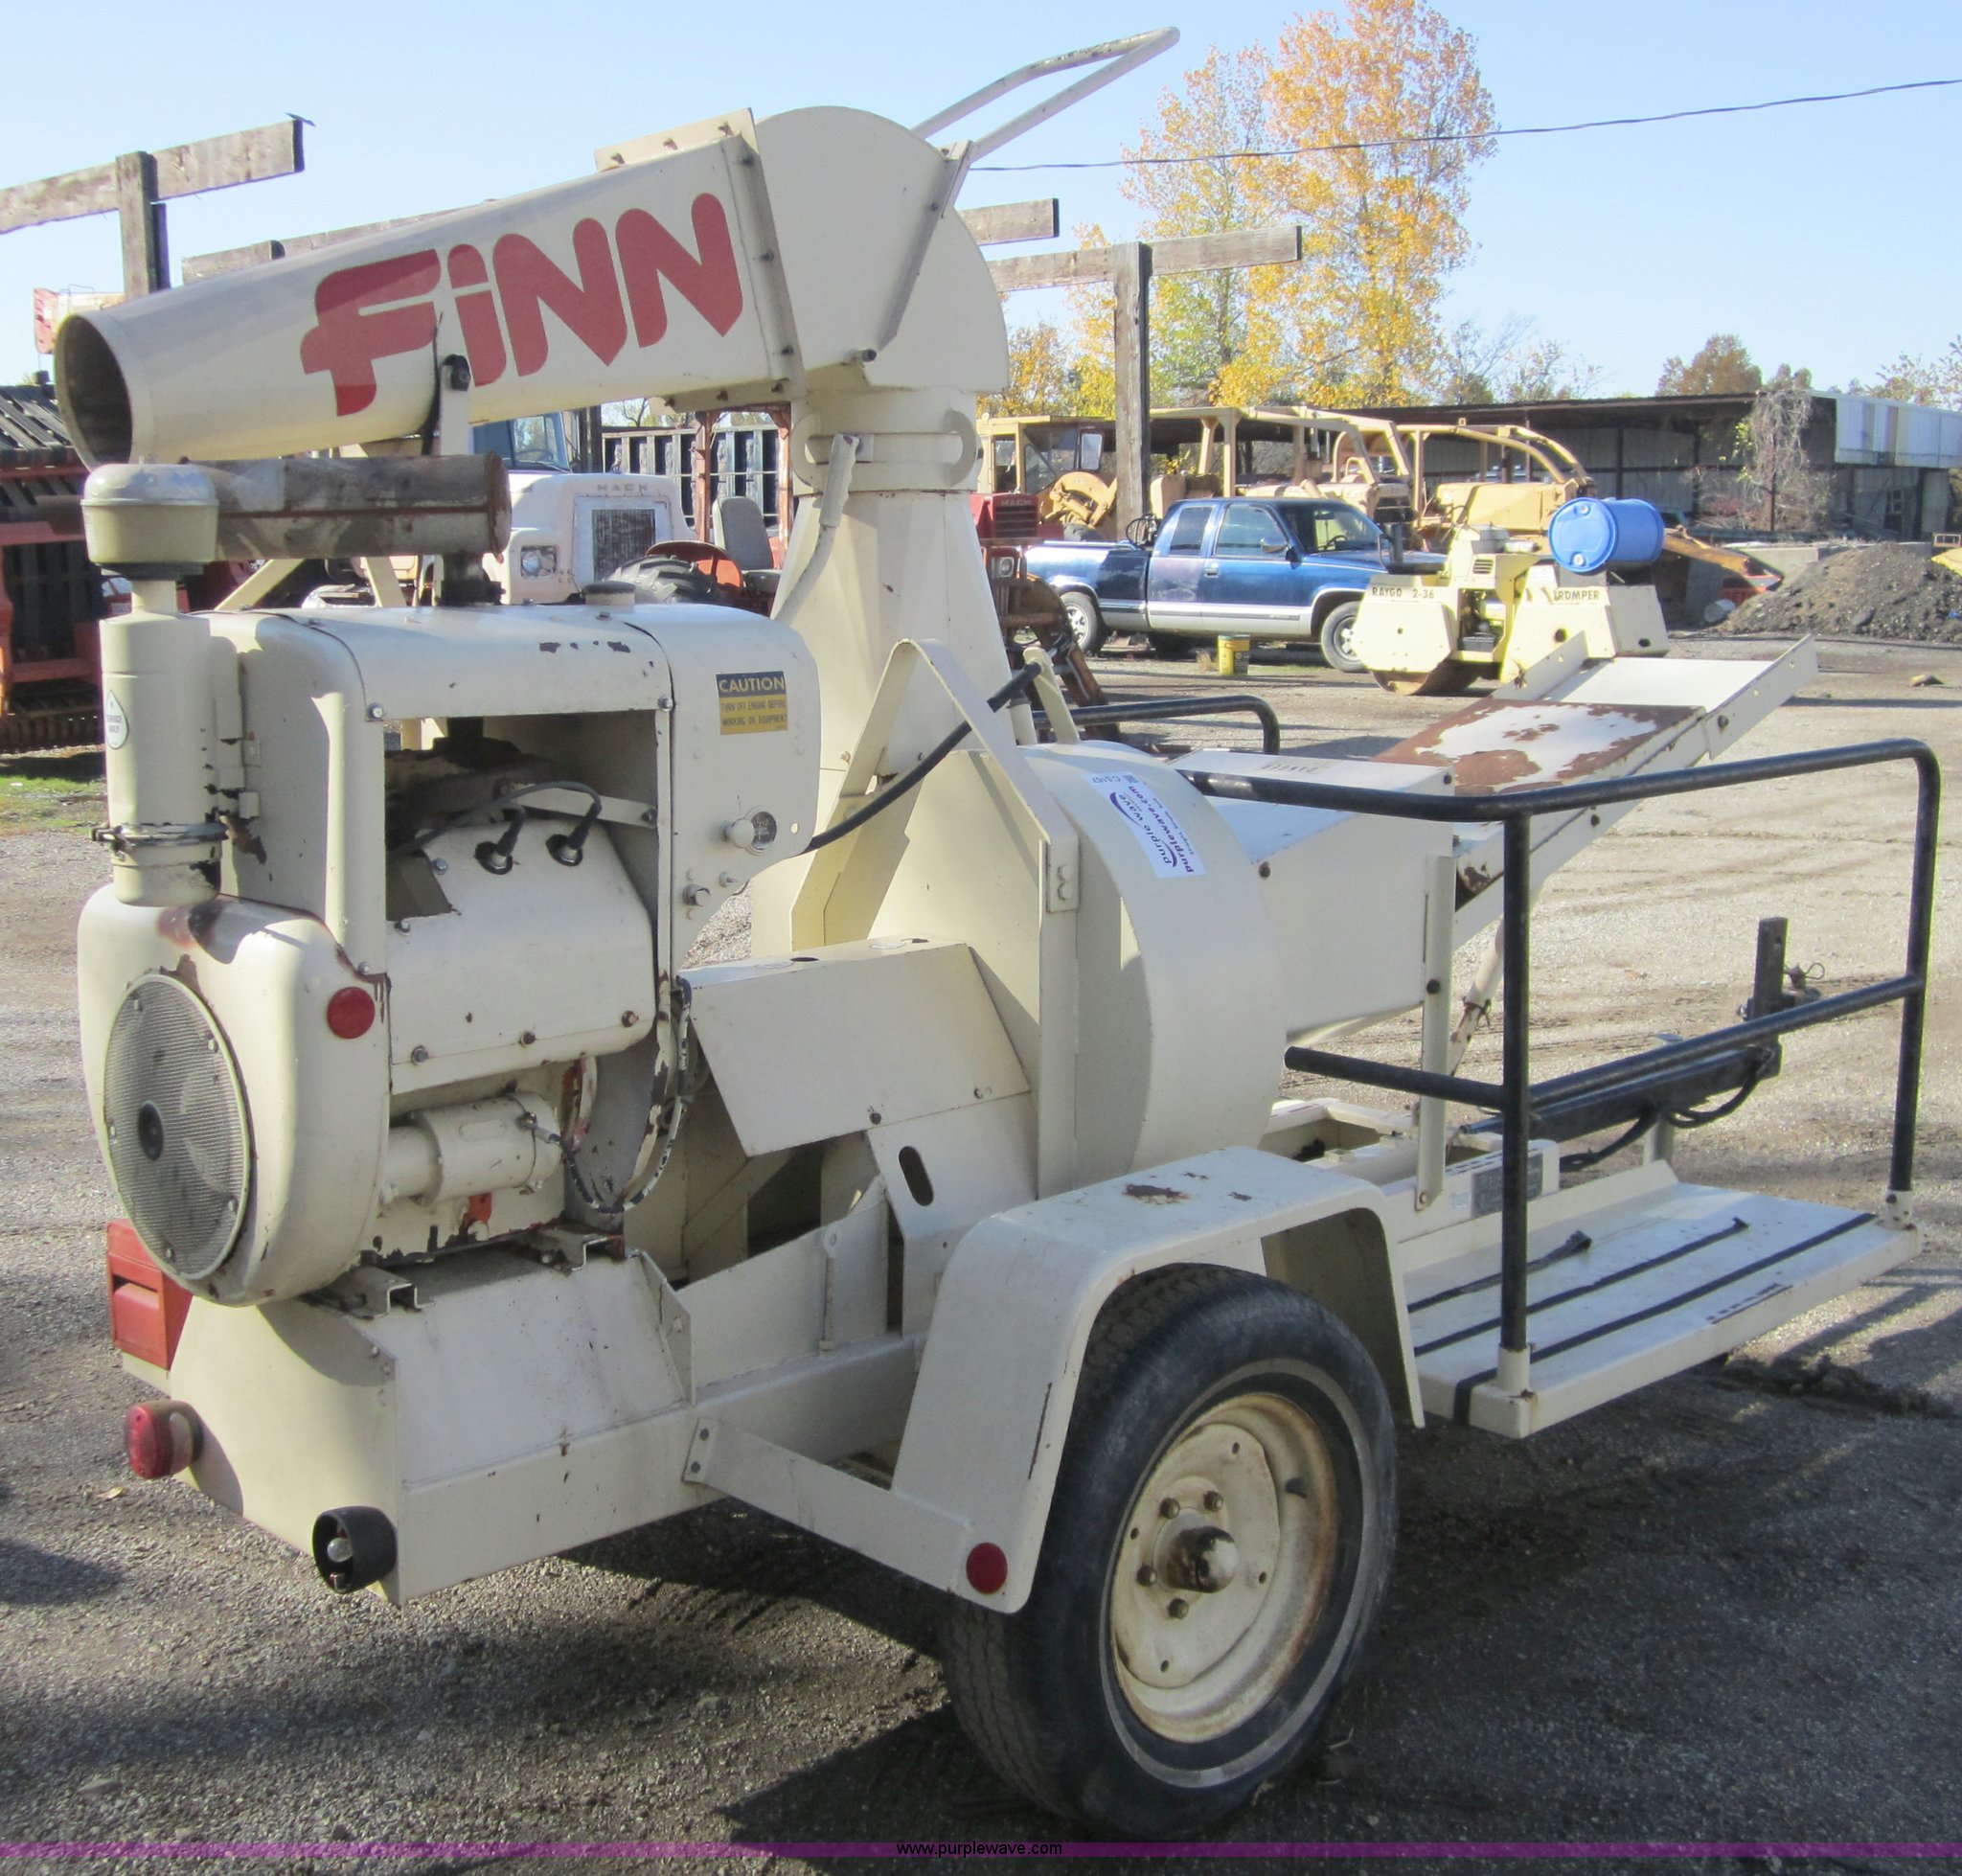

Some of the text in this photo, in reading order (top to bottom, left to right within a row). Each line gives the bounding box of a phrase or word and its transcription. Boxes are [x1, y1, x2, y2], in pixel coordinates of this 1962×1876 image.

[597, 484, 649, 492] MACK
[1372, 586, 1435, 599] RAYGO 2-36
[1558, 589, 1600, 601] ROMPER
[719, 676, 785, 693] CAUTION
[1119, 793, 1144, 821] wave
[1129, 786, 1195, 873] purplewave.com
[1144, 824, 1173, 864] purple
